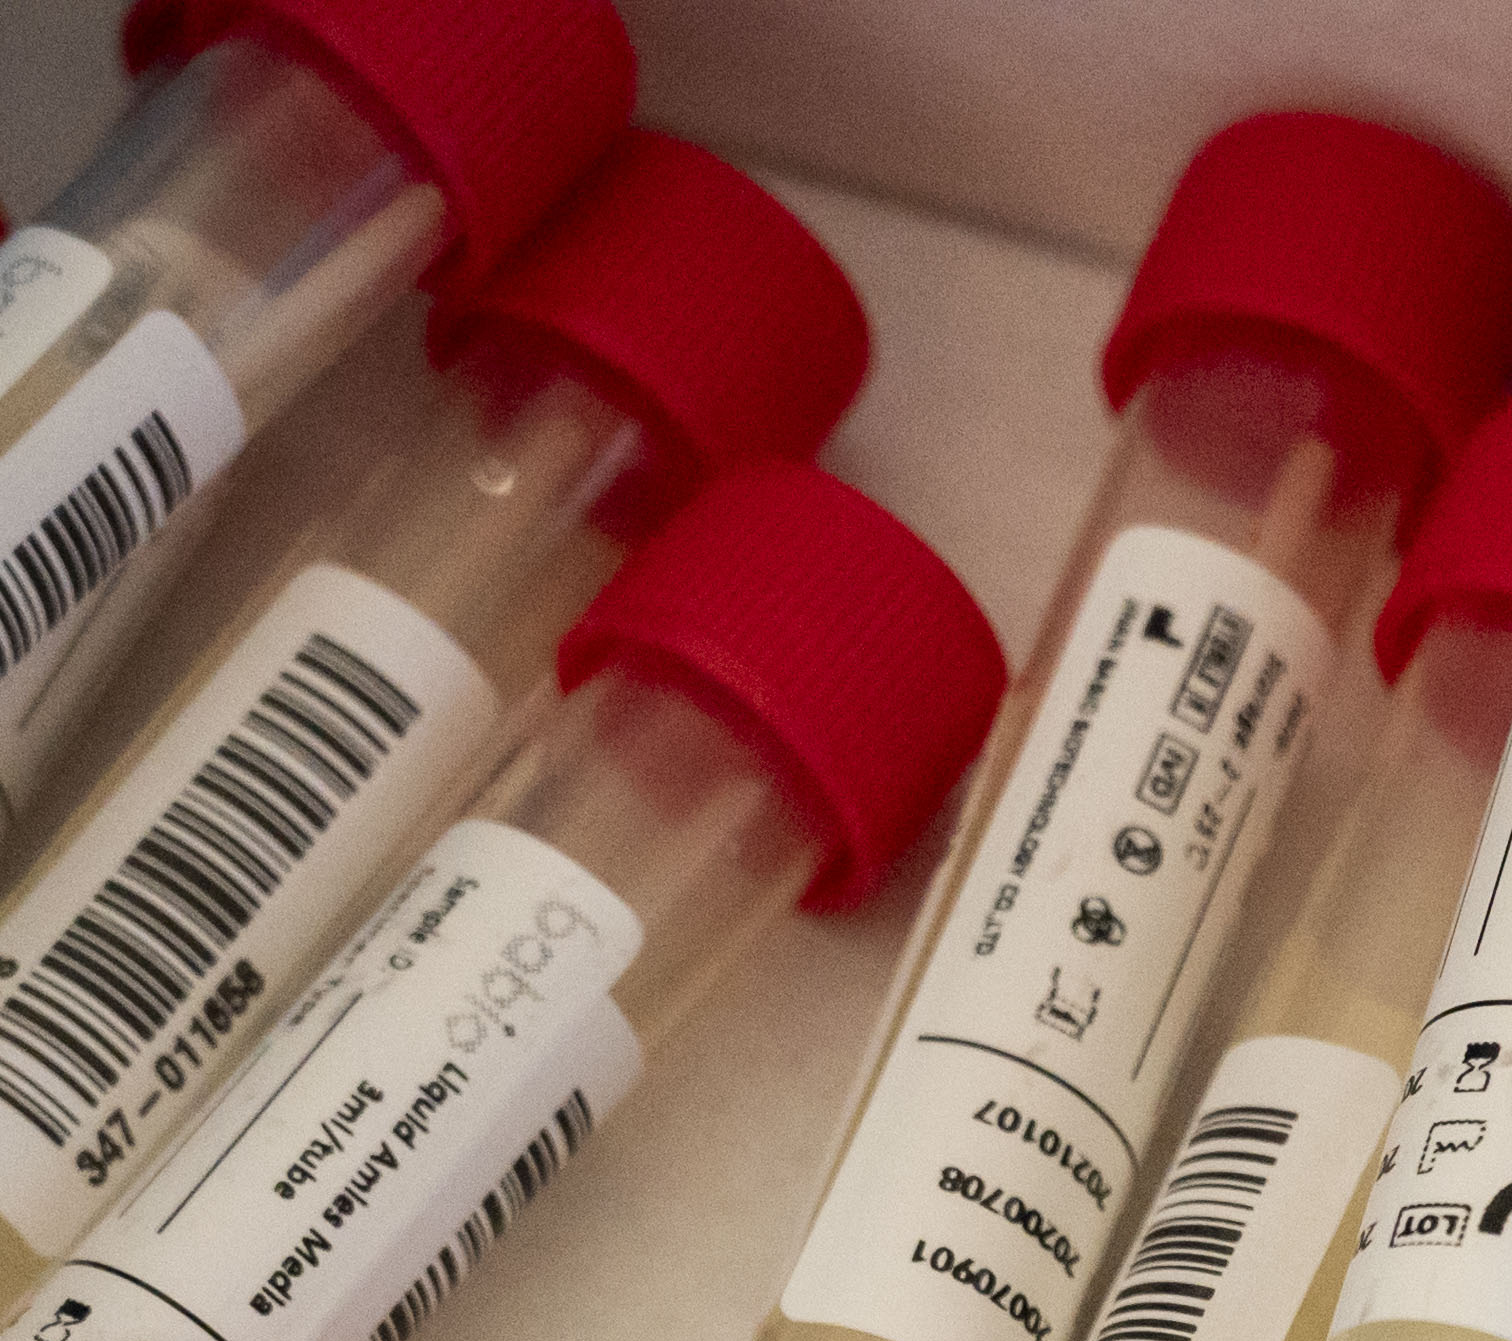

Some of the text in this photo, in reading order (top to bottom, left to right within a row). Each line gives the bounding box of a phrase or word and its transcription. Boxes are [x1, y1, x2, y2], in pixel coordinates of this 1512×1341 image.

[406, 872, 480, 948] Sample
[273, 1080, 384, 1201] 3ml/tube
[391, 1061, 469, 1150] Liquid
[321, 1141, 400, 1229] Amies
[1396, 1208, 1459, 1240] LOT
[248, 1227, 333, 1317] Media
